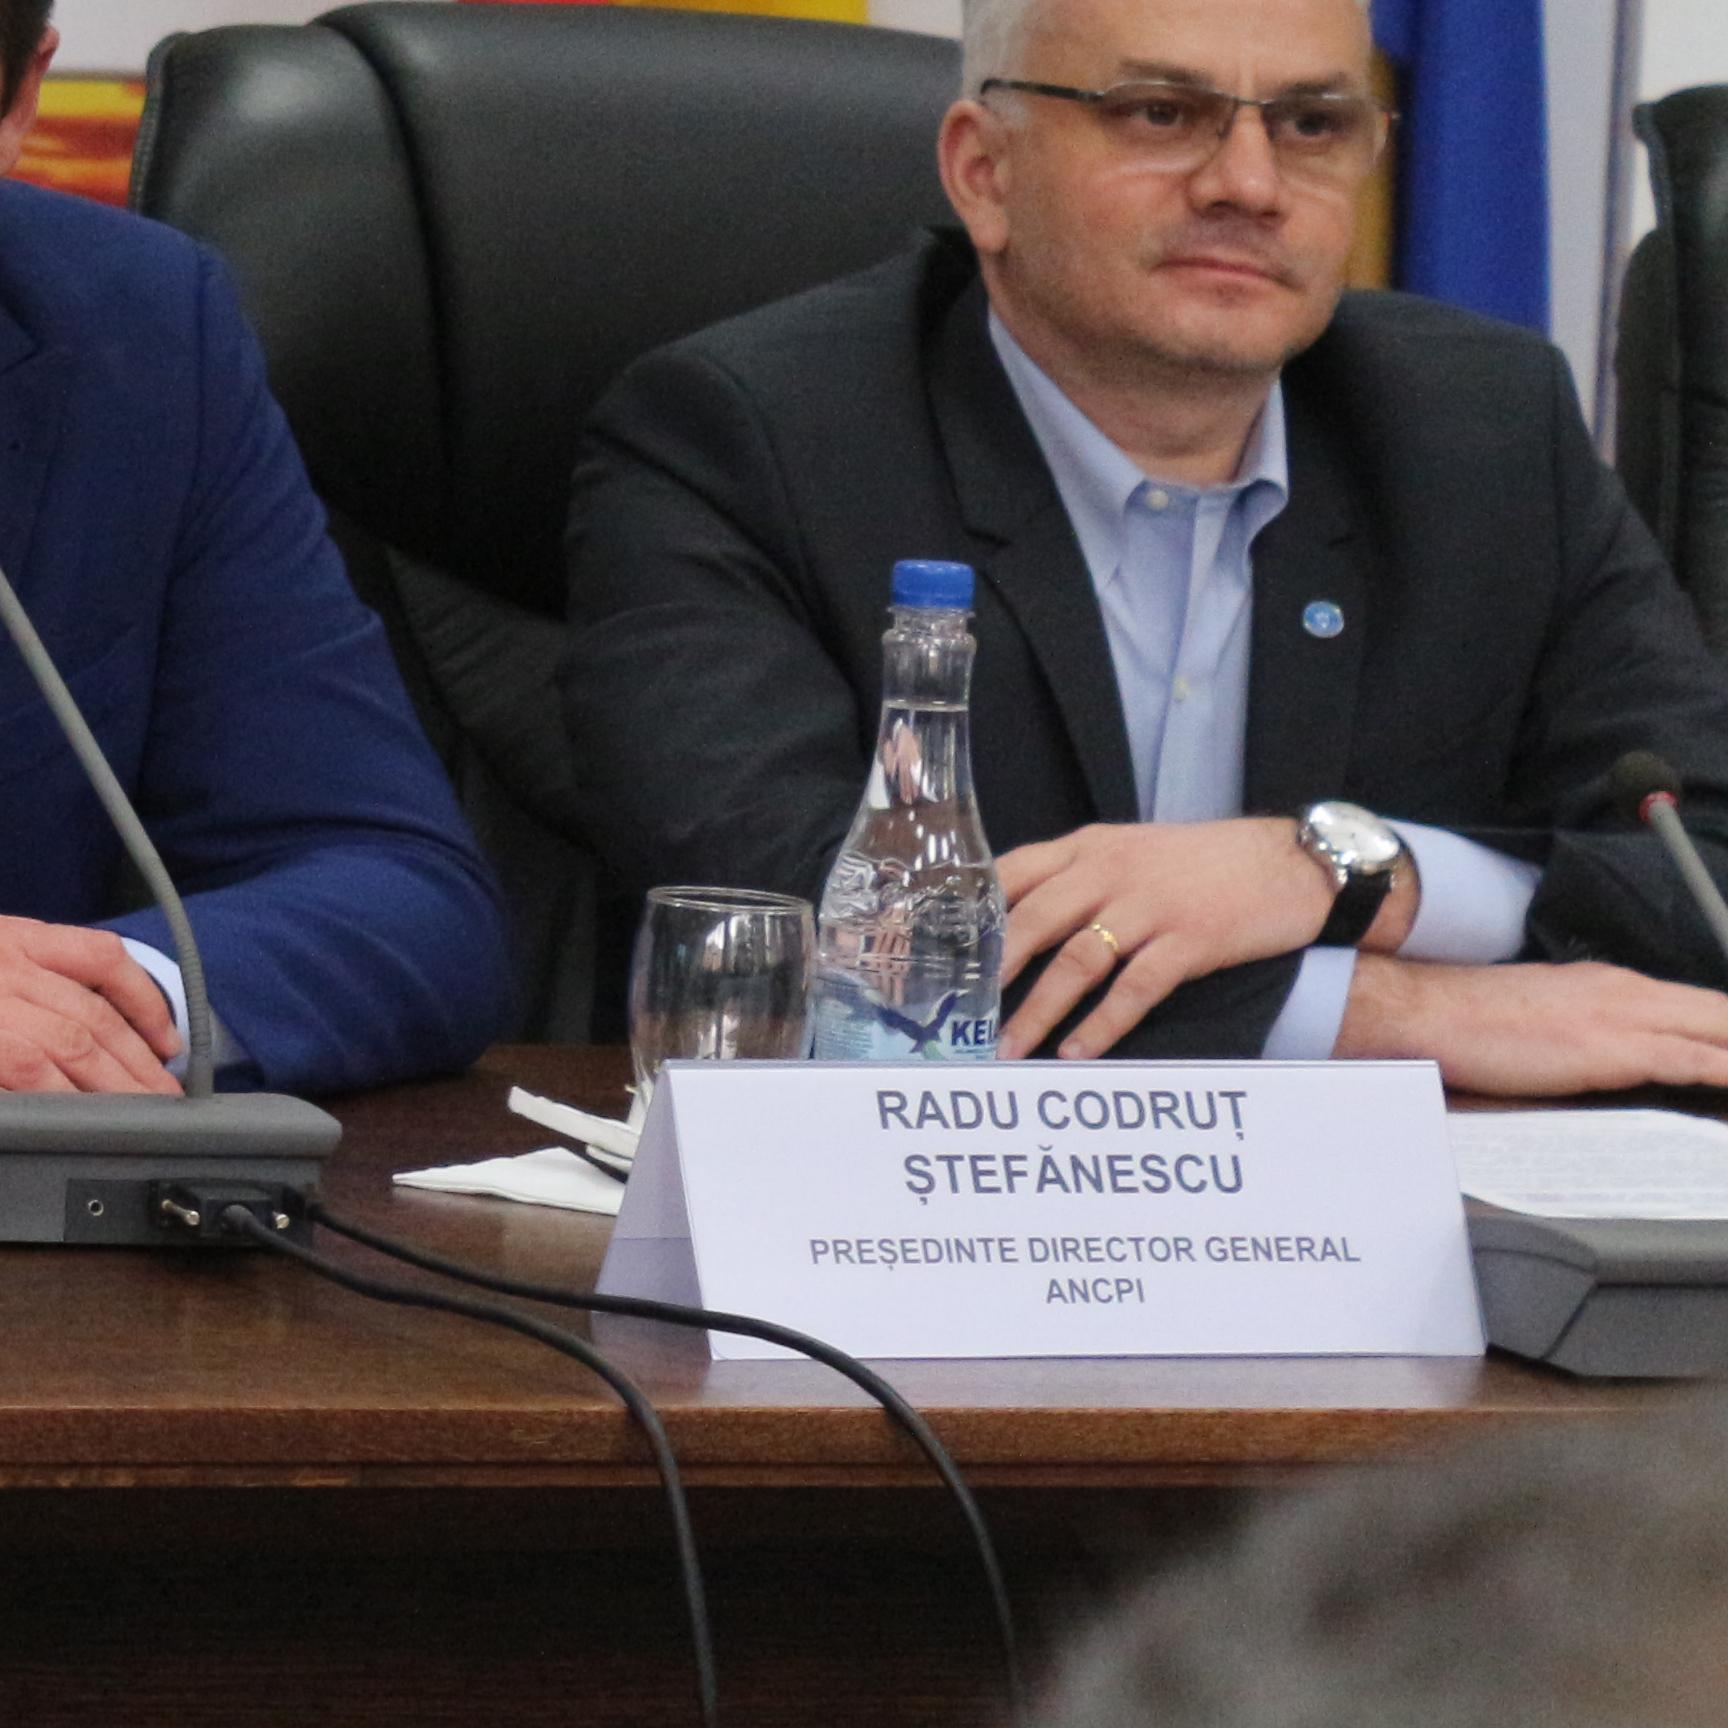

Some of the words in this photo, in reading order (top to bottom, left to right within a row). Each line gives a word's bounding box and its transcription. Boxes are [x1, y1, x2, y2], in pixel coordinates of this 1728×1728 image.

[876, 1090, 1020, 1131] RADU
[1037, 1090, 1248, 1141] CODRUȚ
[904, 1145, 1244, 1205] ȘTEFĂNESCU
[810, 1237, 1019, 1271] PREȘEDINTE
[1027, 1236, 1197, 1264] DIRECTOR
[1204, 1236, 1362, 1263] GENERAL
[1046, 1278, 1145, 1305] ANCPI
